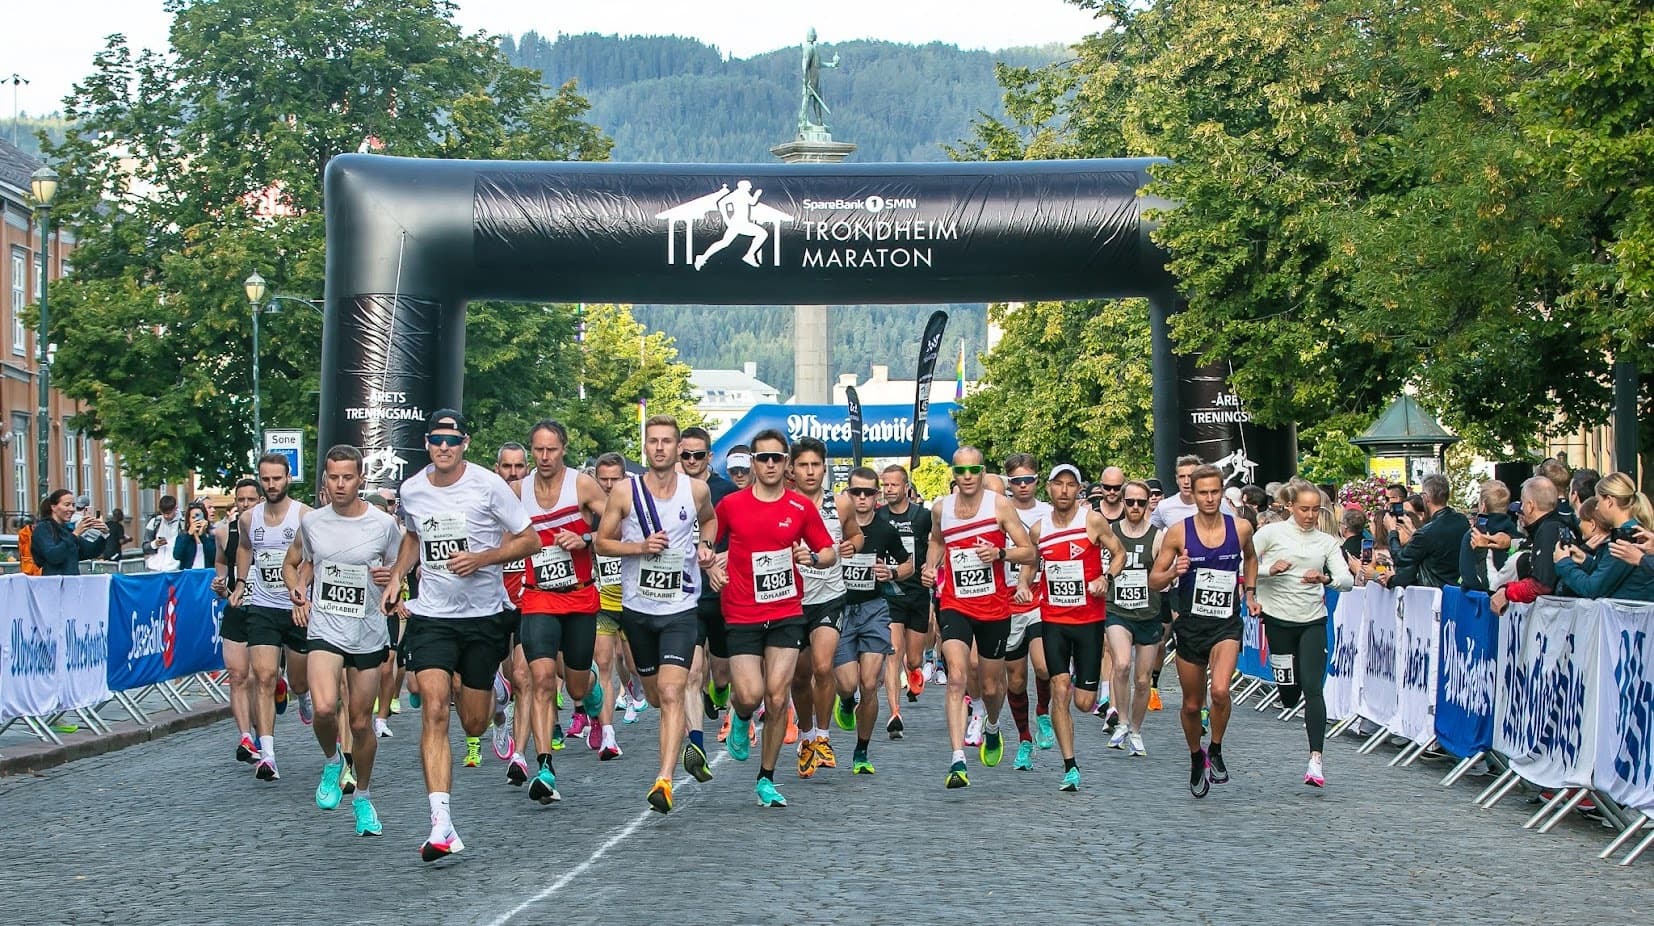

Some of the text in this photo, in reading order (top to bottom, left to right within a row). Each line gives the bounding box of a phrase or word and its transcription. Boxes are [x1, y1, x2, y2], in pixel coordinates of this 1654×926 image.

[803, 198, 864, 211] SpareBank
[885, 198, 916, 209] SMN
[803, 221, 958, 240] TRONDHEIM
[802, 248, 932, 268] MARATON
[345, 406, 426, 421] TRENINGSMÅL
[272, 435, 296, 444] Sone
[430, 540, 460, 560] 509
[541, 562, 567, 581] 428
[646, 571, 673, 588] 421
[844, 566, 868, 580] 467
[960, 569, 986, 586] 522
[762, 571, 787, 591] 498
[1053, 581, 1076, 595] 539
[328, 585, 357, 603] 403
[1120, 588, 1141, 600] 435
[1200, 590, 1225, 606] 543
